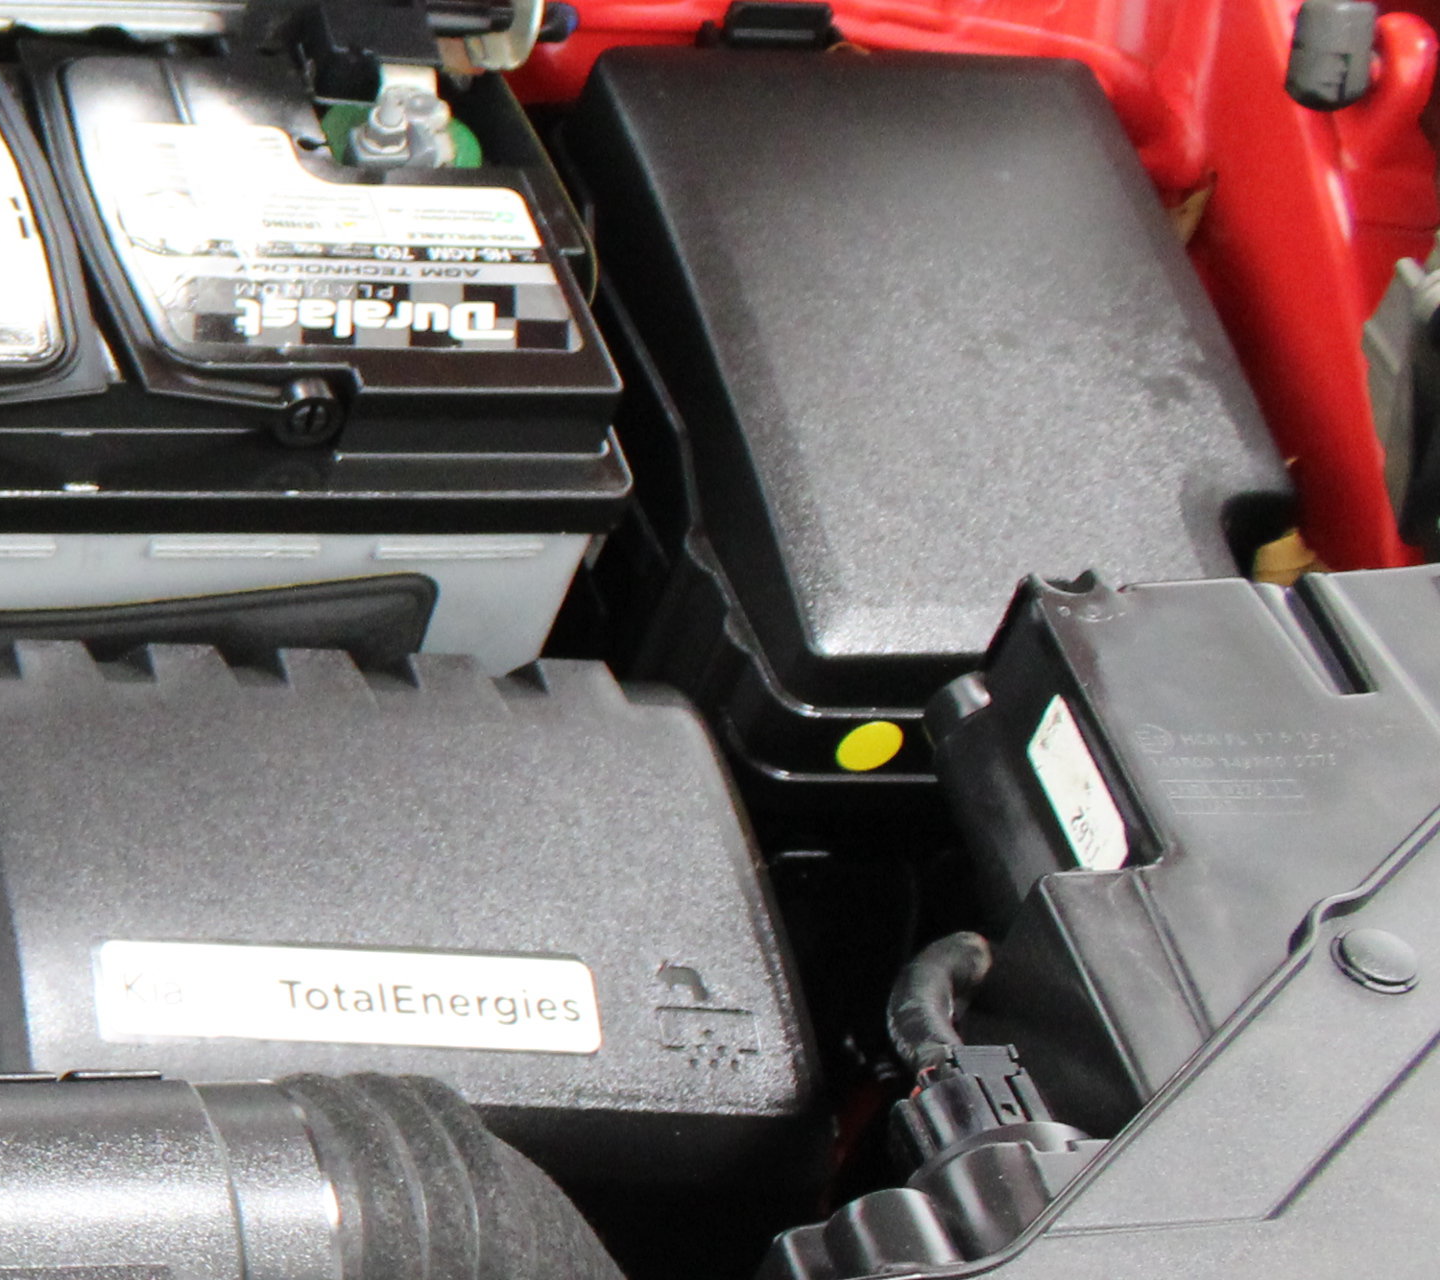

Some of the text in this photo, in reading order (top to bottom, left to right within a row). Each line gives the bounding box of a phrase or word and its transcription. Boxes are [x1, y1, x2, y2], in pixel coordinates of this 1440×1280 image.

[374, 246, 415, 260] 760
[419, 267, 480, 277] AGM
[234, 298, 516, 339] Duralast
[123, 964, 581, 1026] Kia TotalEnergies
